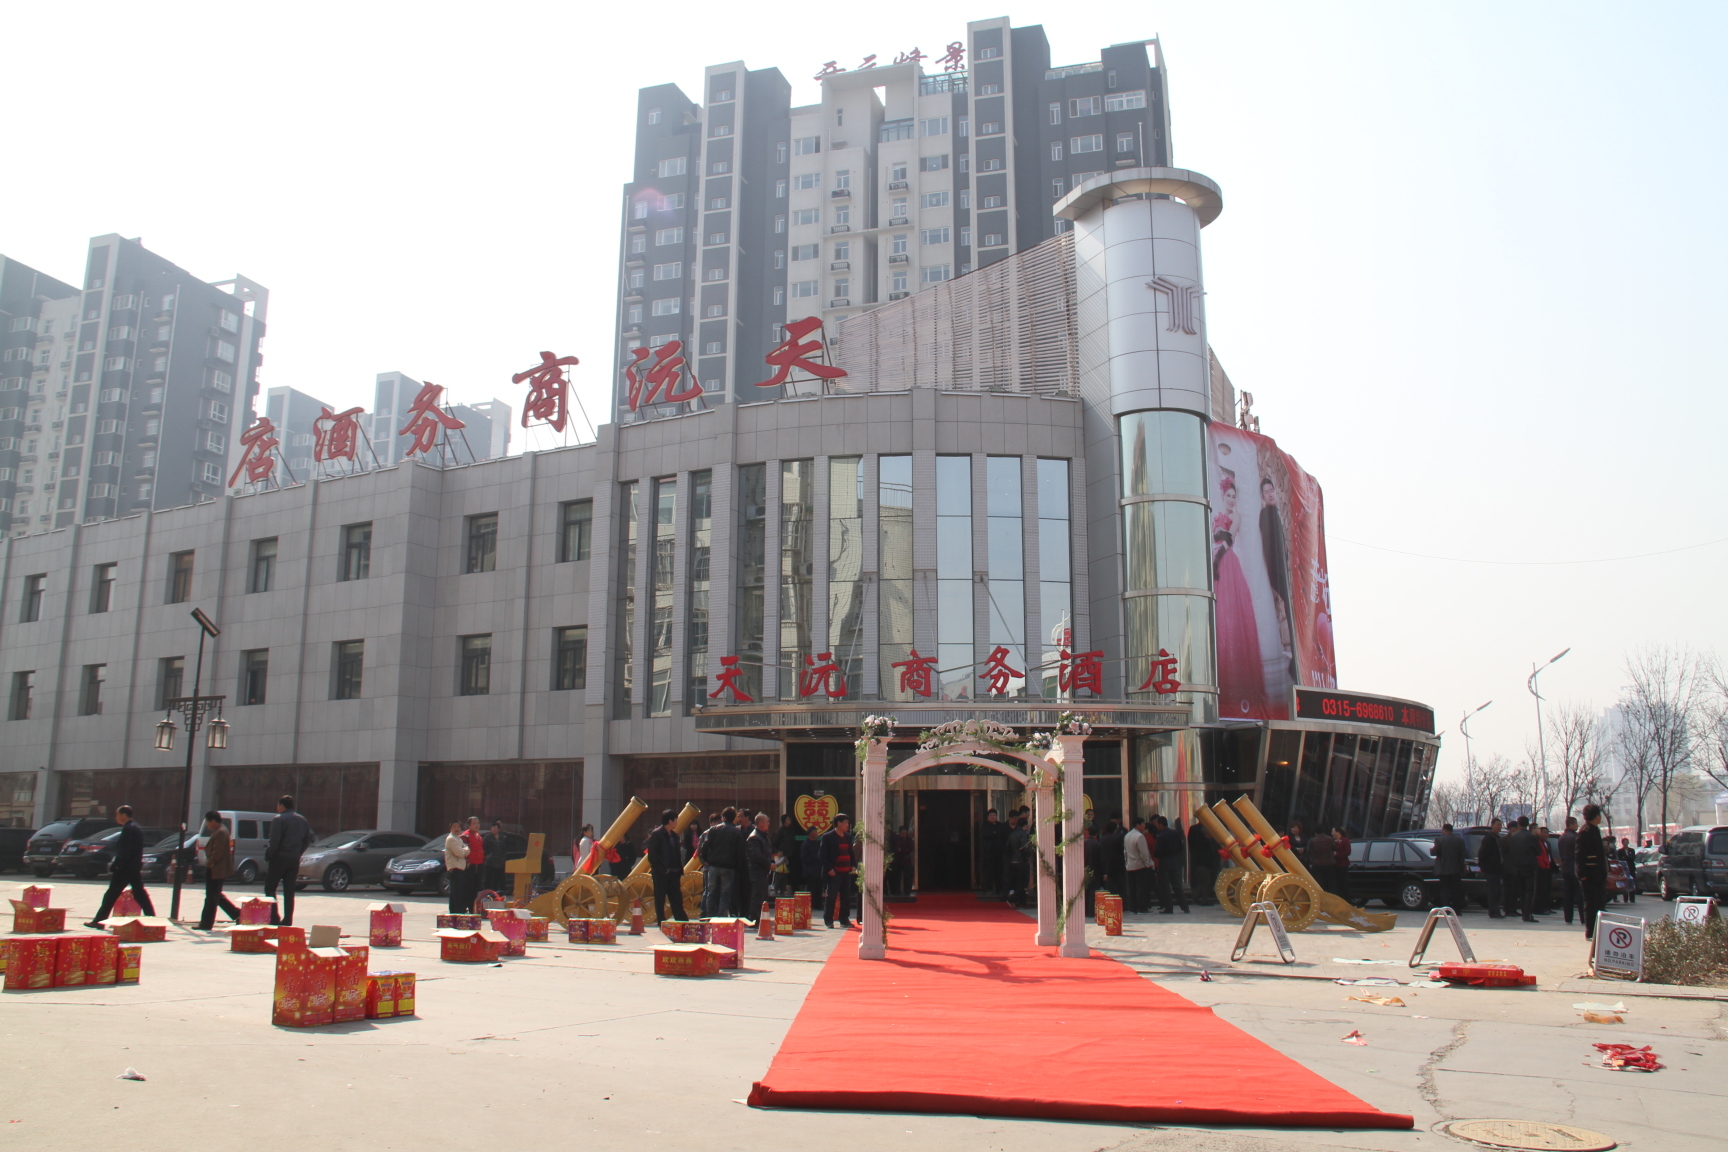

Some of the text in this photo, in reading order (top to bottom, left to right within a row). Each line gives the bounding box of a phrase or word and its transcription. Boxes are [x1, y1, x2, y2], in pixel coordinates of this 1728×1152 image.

[708, 645, 1182, 701] 天沅商务酒店
[1322, 698, 1394, 722] 0315-6968610
